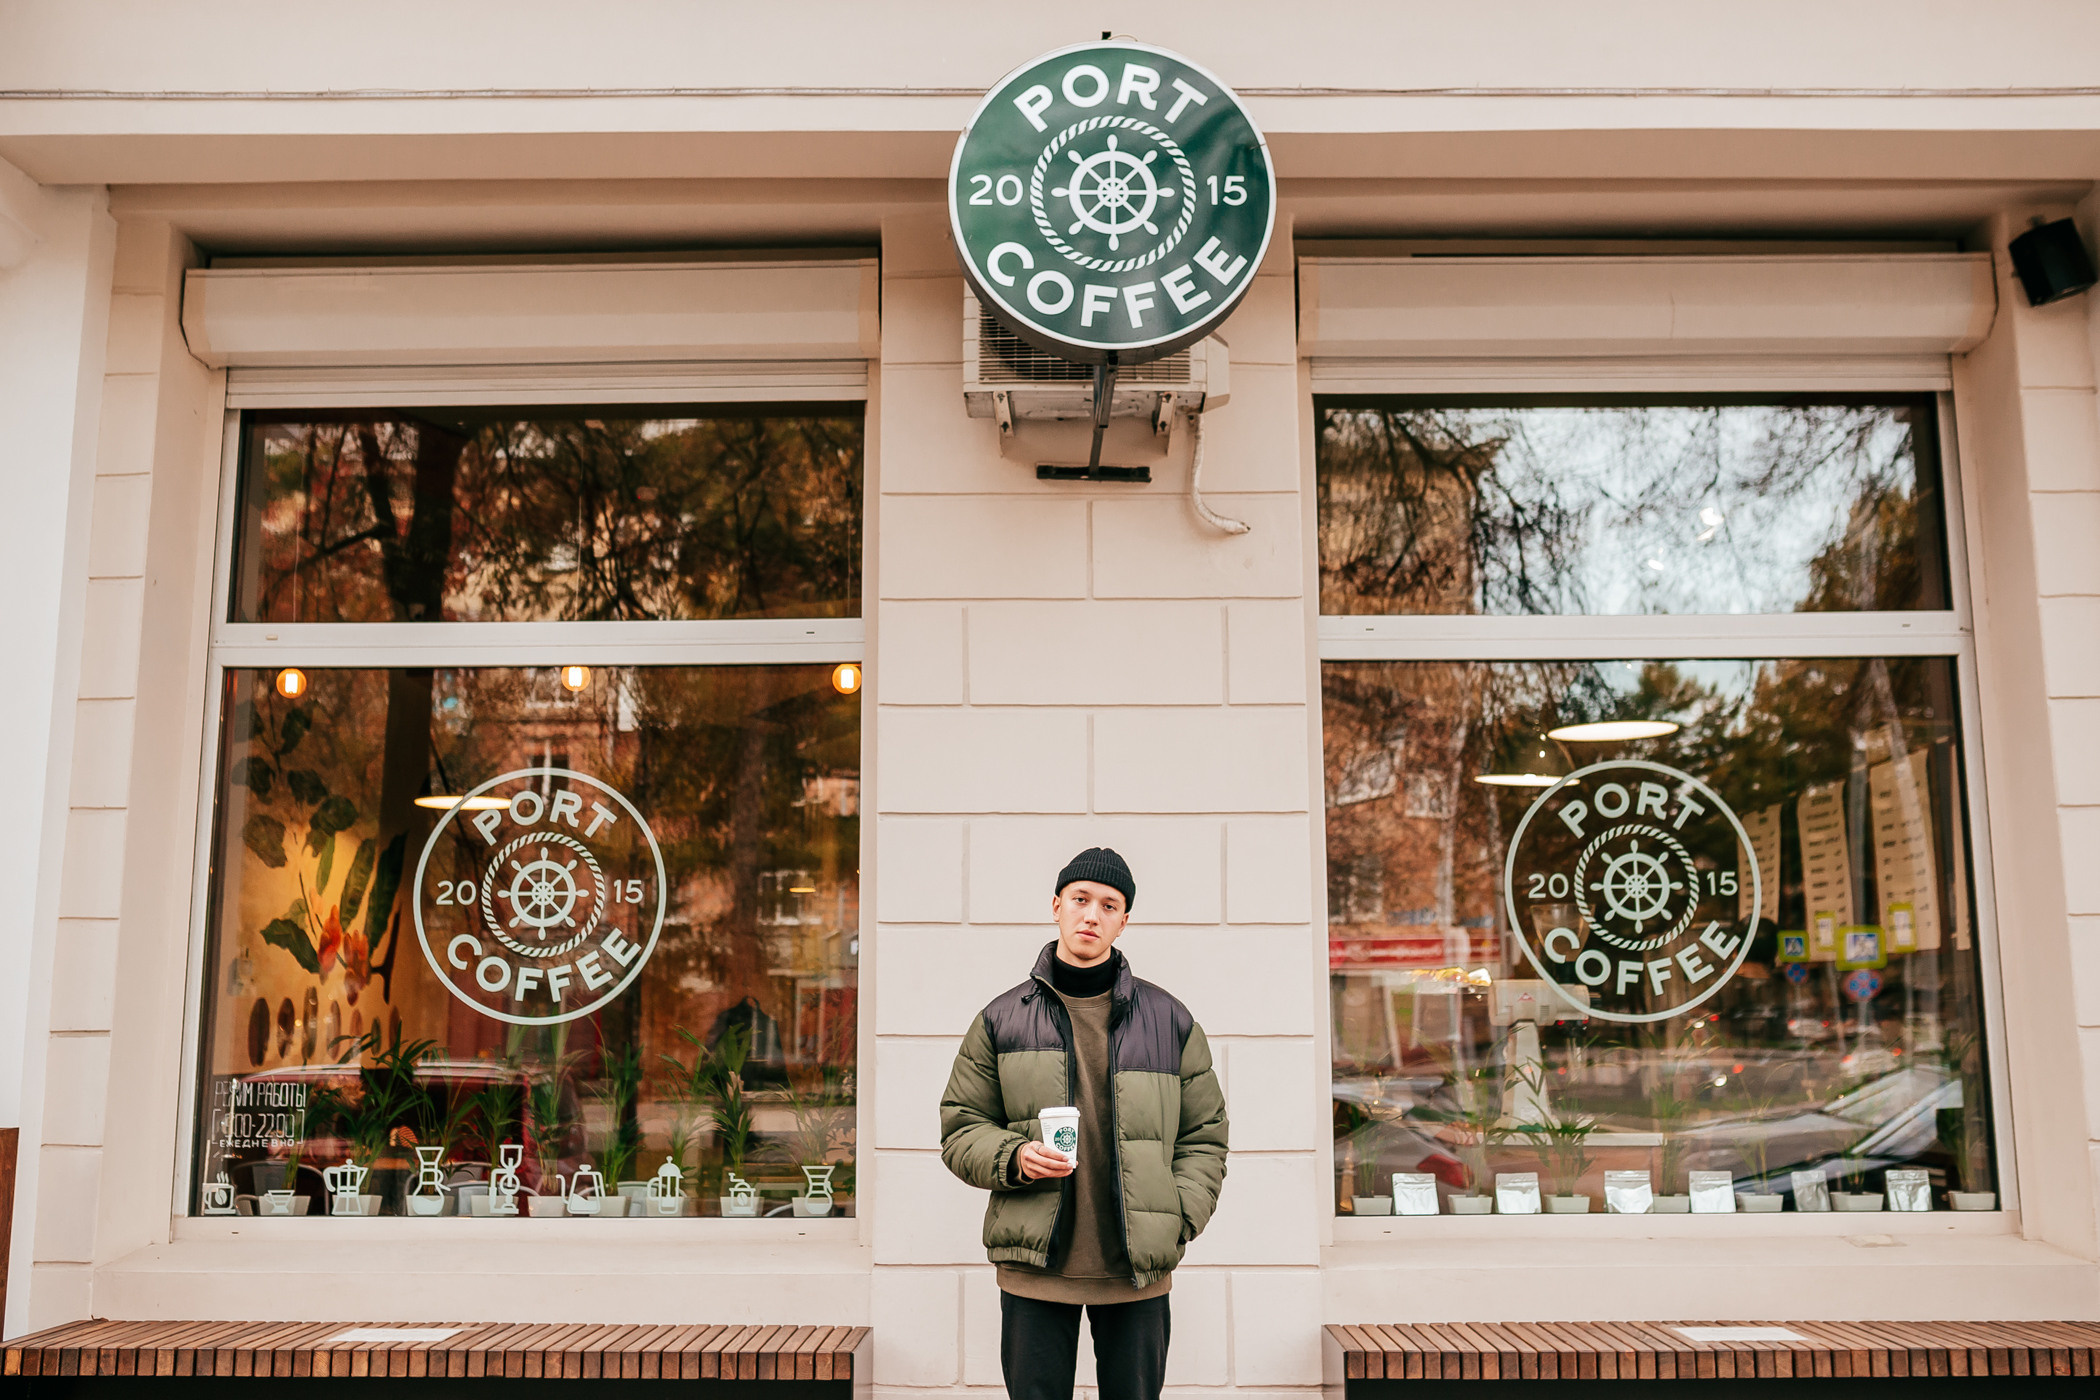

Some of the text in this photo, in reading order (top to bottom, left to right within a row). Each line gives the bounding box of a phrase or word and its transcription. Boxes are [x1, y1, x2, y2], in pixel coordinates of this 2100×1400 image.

[1012, 62, 1208, 133] PORT
[969, 174, 1248, 207] 20 15
[986, 235, 1248, 328] COFFEE
[472, 789, 617, 846] PORT
[1558, 781, 1705, 839] PORT
[436, 879, 643, 906] 20 15
[1528, 871, 1738, 899] 20 15
[447, 927, 642, 1003] COFFEE
[1544, 919, 1741, 996] COFFEE
[256, 1081, 306, 1107] РАБОТЫ
[219, 1138, 295, 1149] ЕЖЕДНЕВНО
